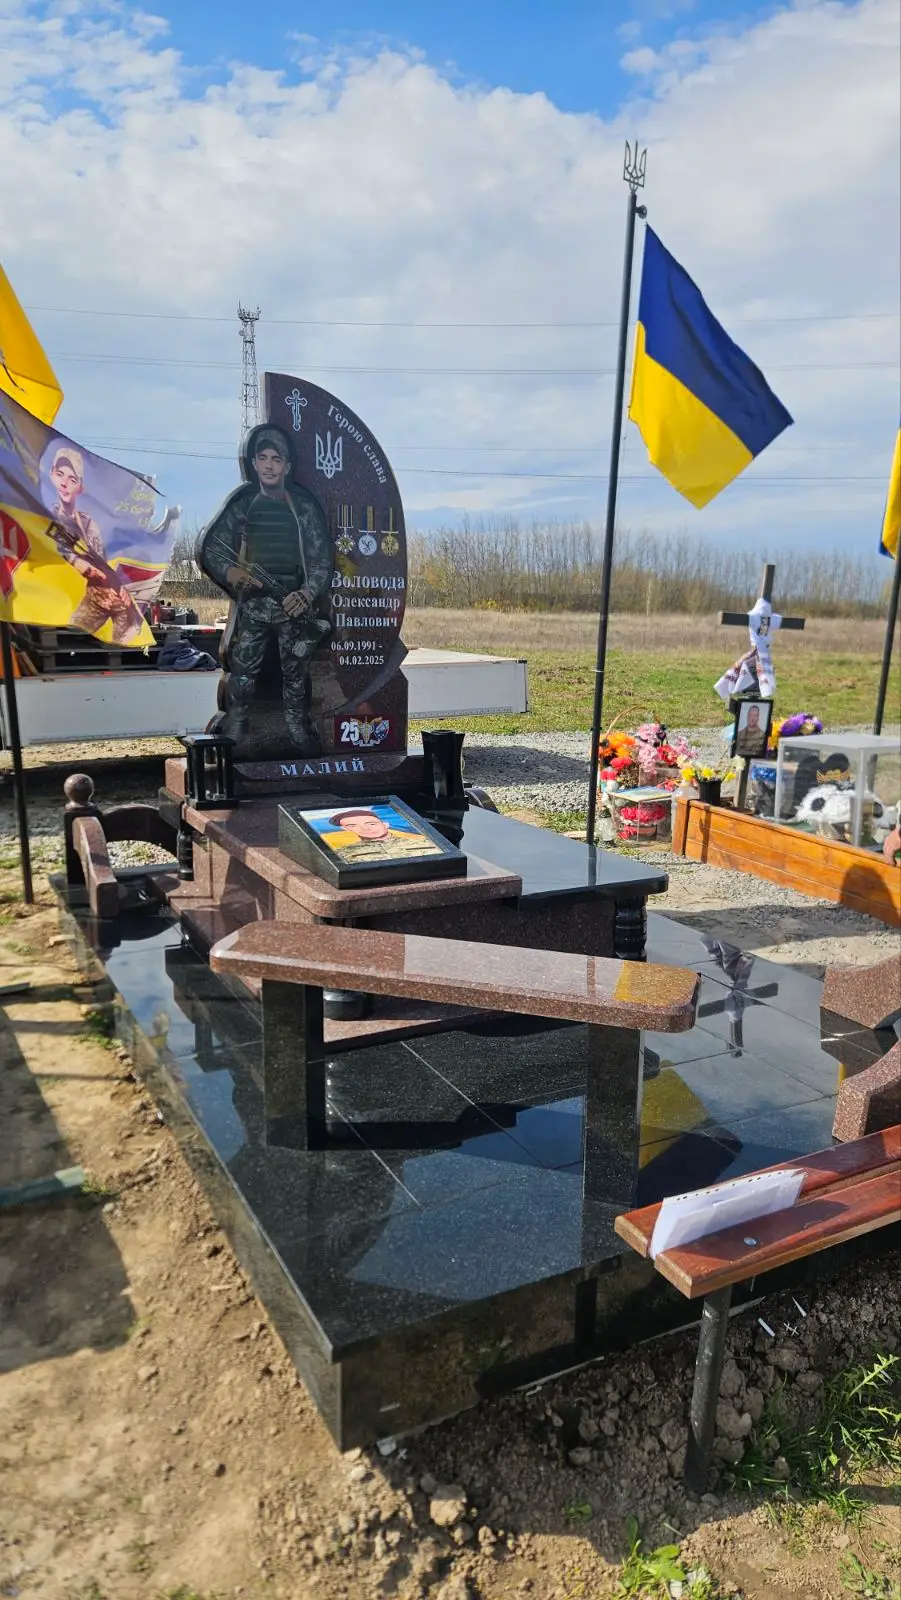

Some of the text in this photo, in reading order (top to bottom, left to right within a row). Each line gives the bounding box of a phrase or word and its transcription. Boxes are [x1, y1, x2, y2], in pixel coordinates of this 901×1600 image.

[327, 404, 387, 484] Герою слава
[331, 570, 405, 591] Воловода
[332, 594, 400, 611] Олександр
[336, 613, 398, 627] Павлович
[331, 641, 376, 651] 06.09.1991
[340, 655, 384, 665] 04.02.2025
[340, 721, 360, 742] 25
[280, 758, 365, 776] МАЛИЙ
